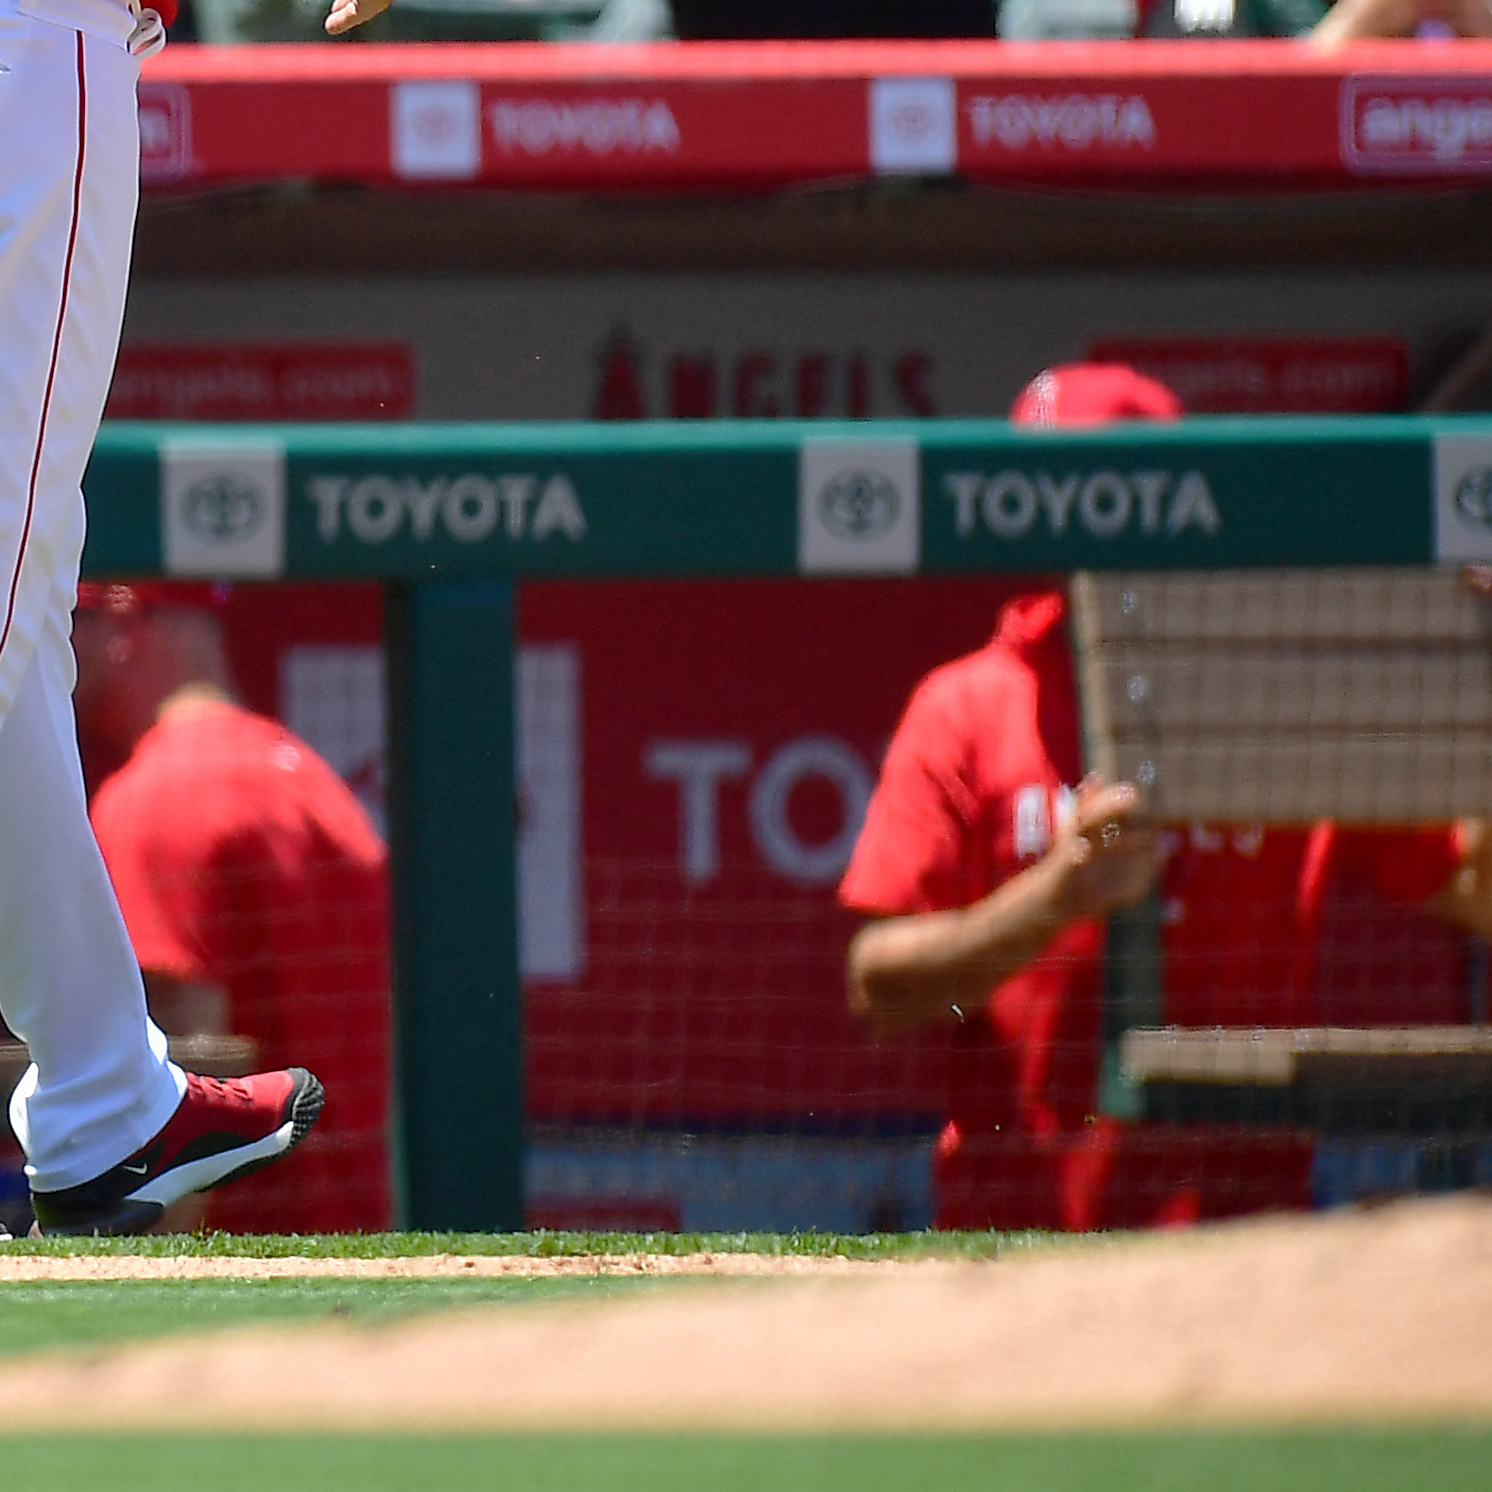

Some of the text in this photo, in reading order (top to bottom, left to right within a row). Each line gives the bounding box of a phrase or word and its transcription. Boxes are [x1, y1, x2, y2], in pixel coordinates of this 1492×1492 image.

[492, 98, 682, 156] TOYOTA
[969, 93, 1157, 151] TOYOTA
[305, 472, 589, 544] TOYOTA
[942, 469, 1224, 541] TOYOTA
